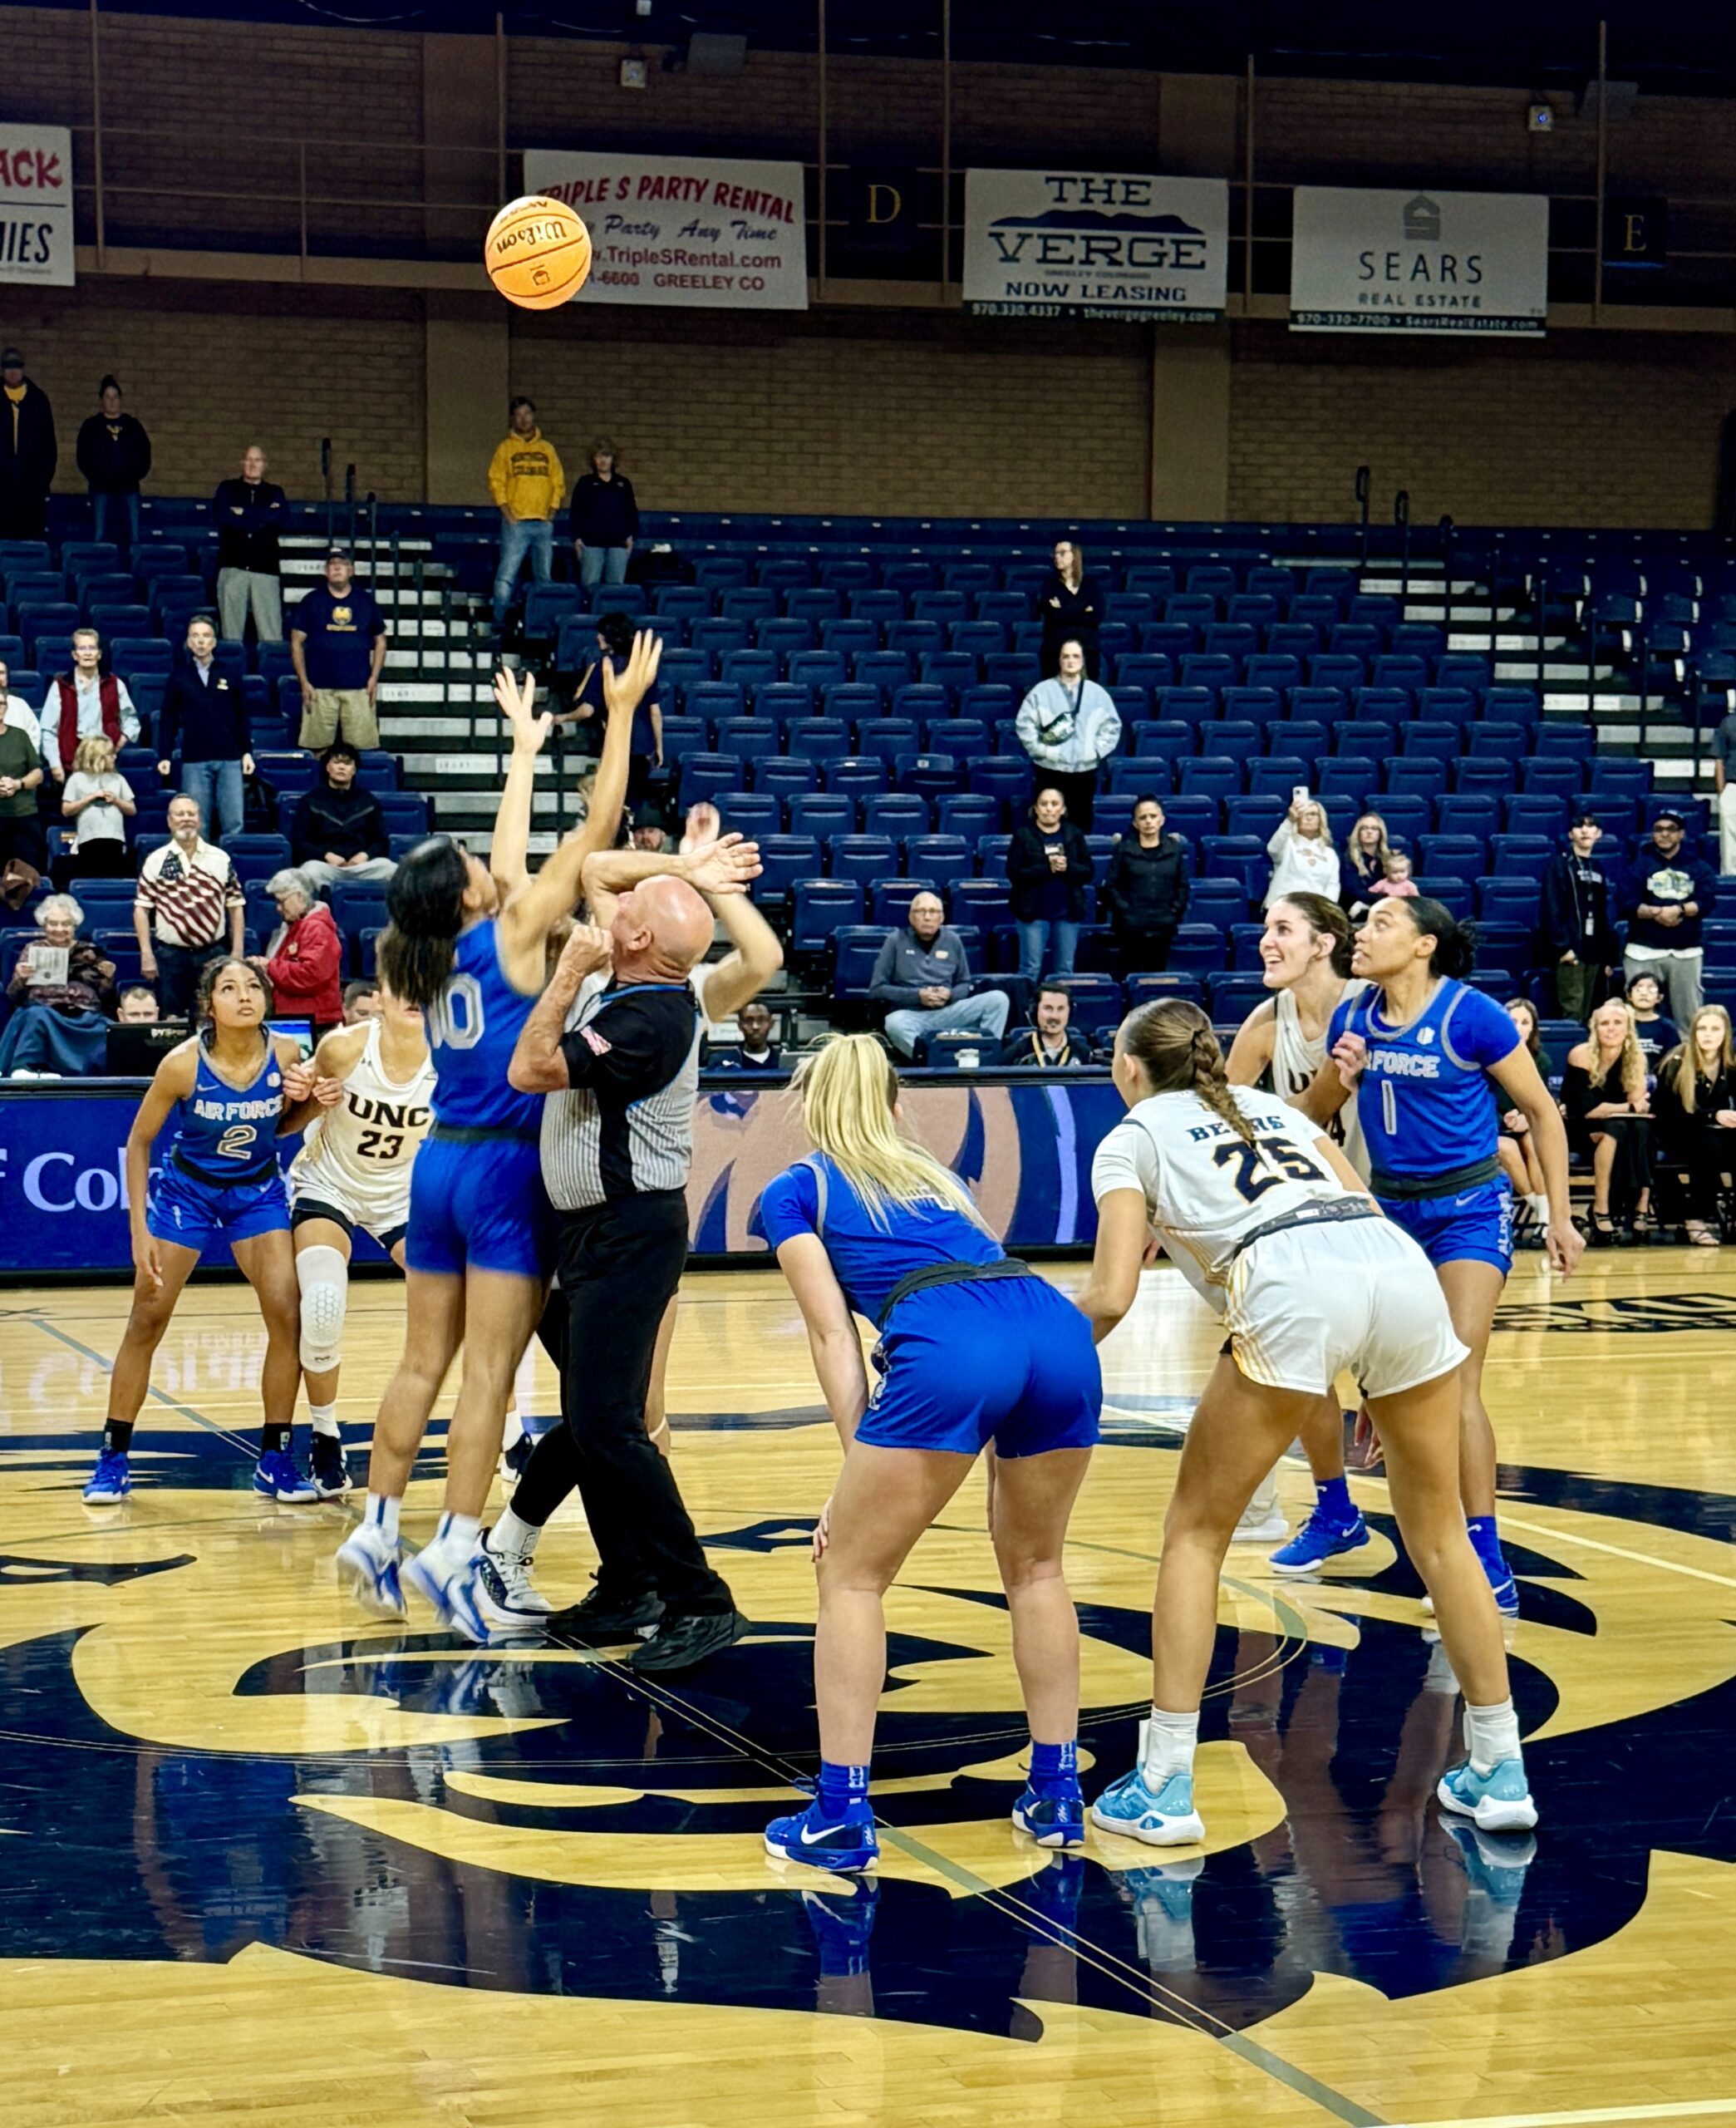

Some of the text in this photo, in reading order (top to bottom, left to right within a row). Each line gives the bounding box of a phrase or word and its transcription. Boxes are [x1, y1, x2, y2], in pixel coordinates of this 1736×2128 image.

[615, 175, 631, 200] S
[637, 175, 710, 203] PARTY
[713, 181, 795, 224] RENTAL
[867, 184, 902, 223] D
[1045, 176, 1152, 206] THE
[496, 221, 568, 254] Wilson
[604, 214, 661, 241] Party
[677, 218, 723, 241] Any
[730, 219, 777, 241] Time
[1624, 214, 1647, 252] E
[591, 247, 782, 268] w.TripleSRental.com
[988, 232, 1207, 269] VERGE
[653, 273, 733, 291] GREELEY
[739, 276, 765, 291] CO
[1359, 251, 1483, 283] SEARS
[1006, 282, 1187, 302] NOW LEASING
[1358, 293, 1482, 308] REAL ESTATE
[1371, 1049, 1441, 1078] FORCE
[194, 1099, 225, 1121] AIR
[347, 1091, 430, 1129] UNC
[1380, 1079, 1398, 1136] 1
[217, 1125, 258, 1160] 2
[357, 1130, 405, 1160] 23
[1186, 1116, 1286, 1143] BERS
[1211, 1135, 1331, 1204] 25
